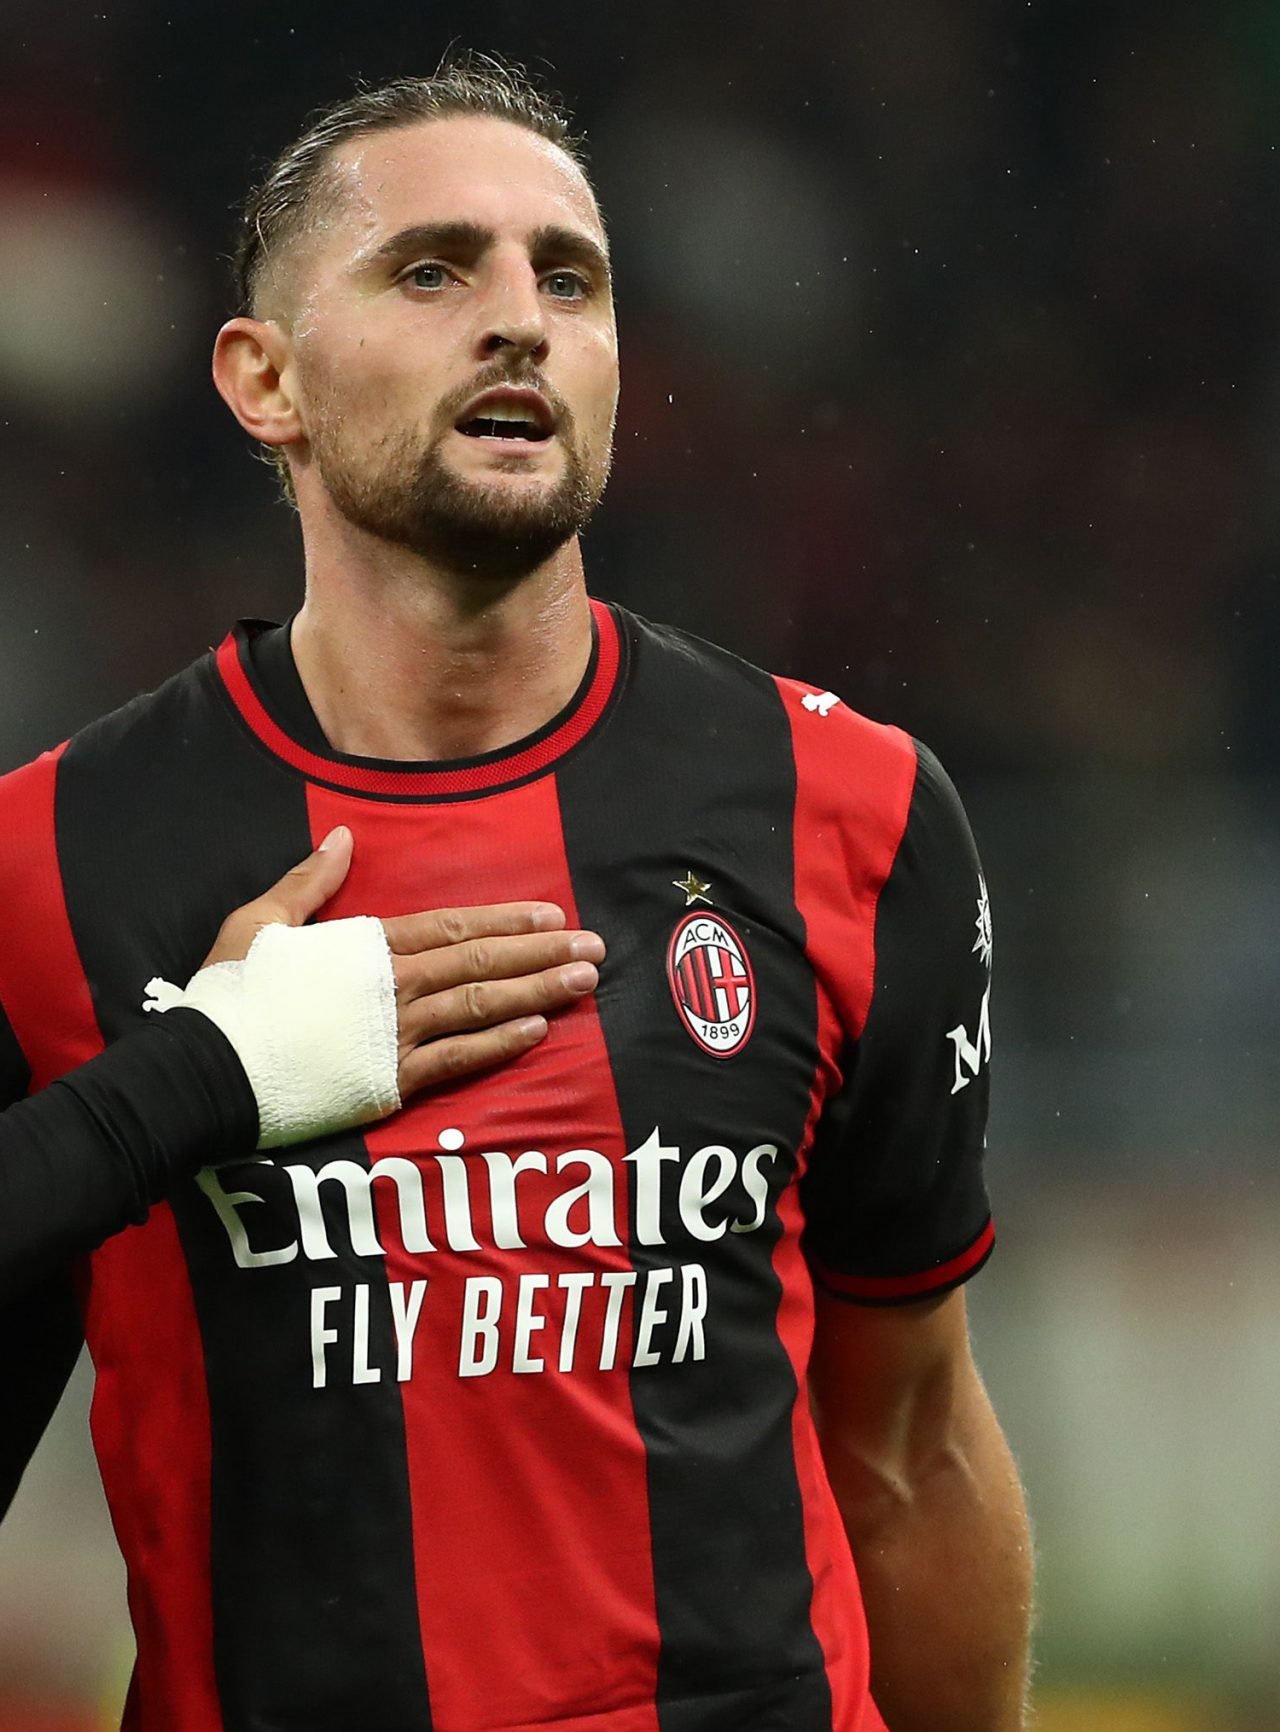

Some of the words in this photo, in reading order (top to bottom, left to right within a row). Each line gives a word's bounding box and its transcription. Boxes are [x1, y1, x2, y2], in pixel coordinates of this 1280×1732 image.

[683, 923, 730, 950] ACM
[701, 1022, 740, 1040] 1899
[193, 1125, 778, 1269] Emirates
[310, 1280, 428, 1388] FLY
[458, 1264, 708, 1378] BETTER
